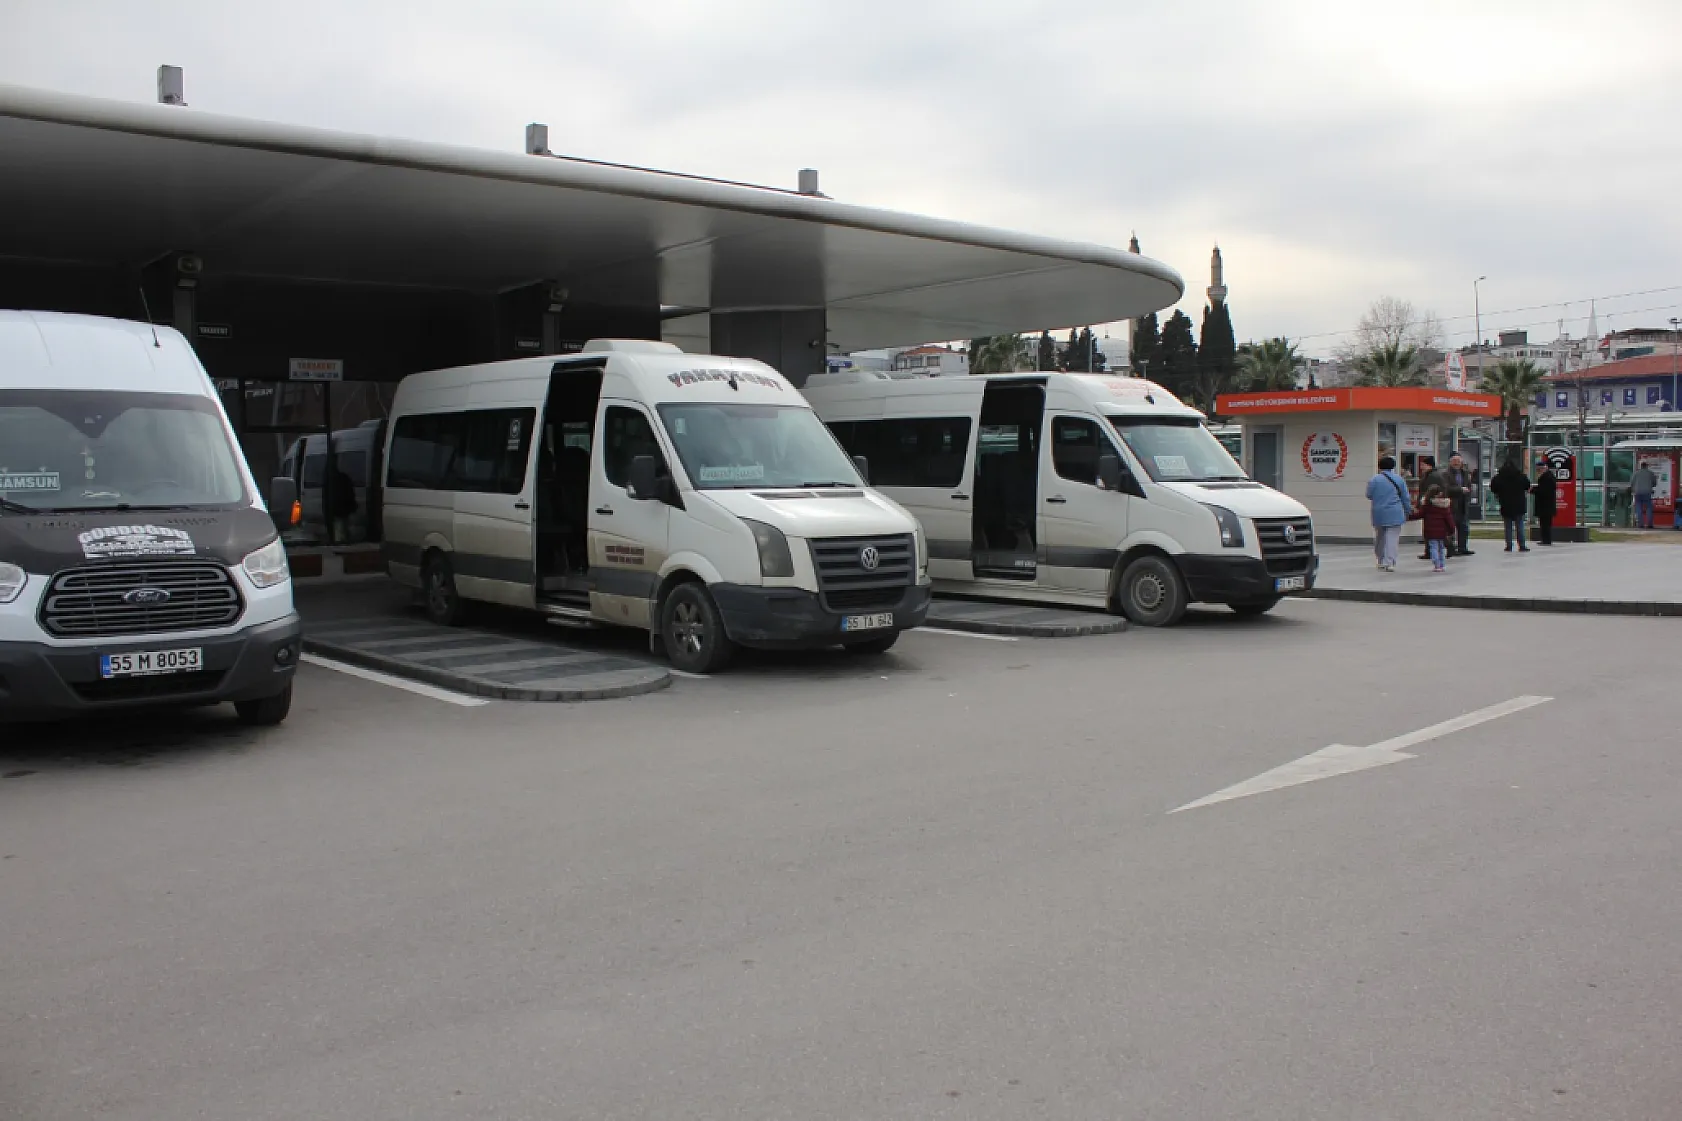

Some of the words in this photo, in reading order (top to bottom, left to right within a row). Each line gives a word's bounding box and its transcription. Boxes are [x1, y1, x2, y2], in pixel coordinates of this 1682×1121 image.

[1310, 448, 1339, 456] SAMSUN
[110, 656, 132, 671] 55
[138, 654, 151, 669] M
[157, 650, 197, 667] 8053
